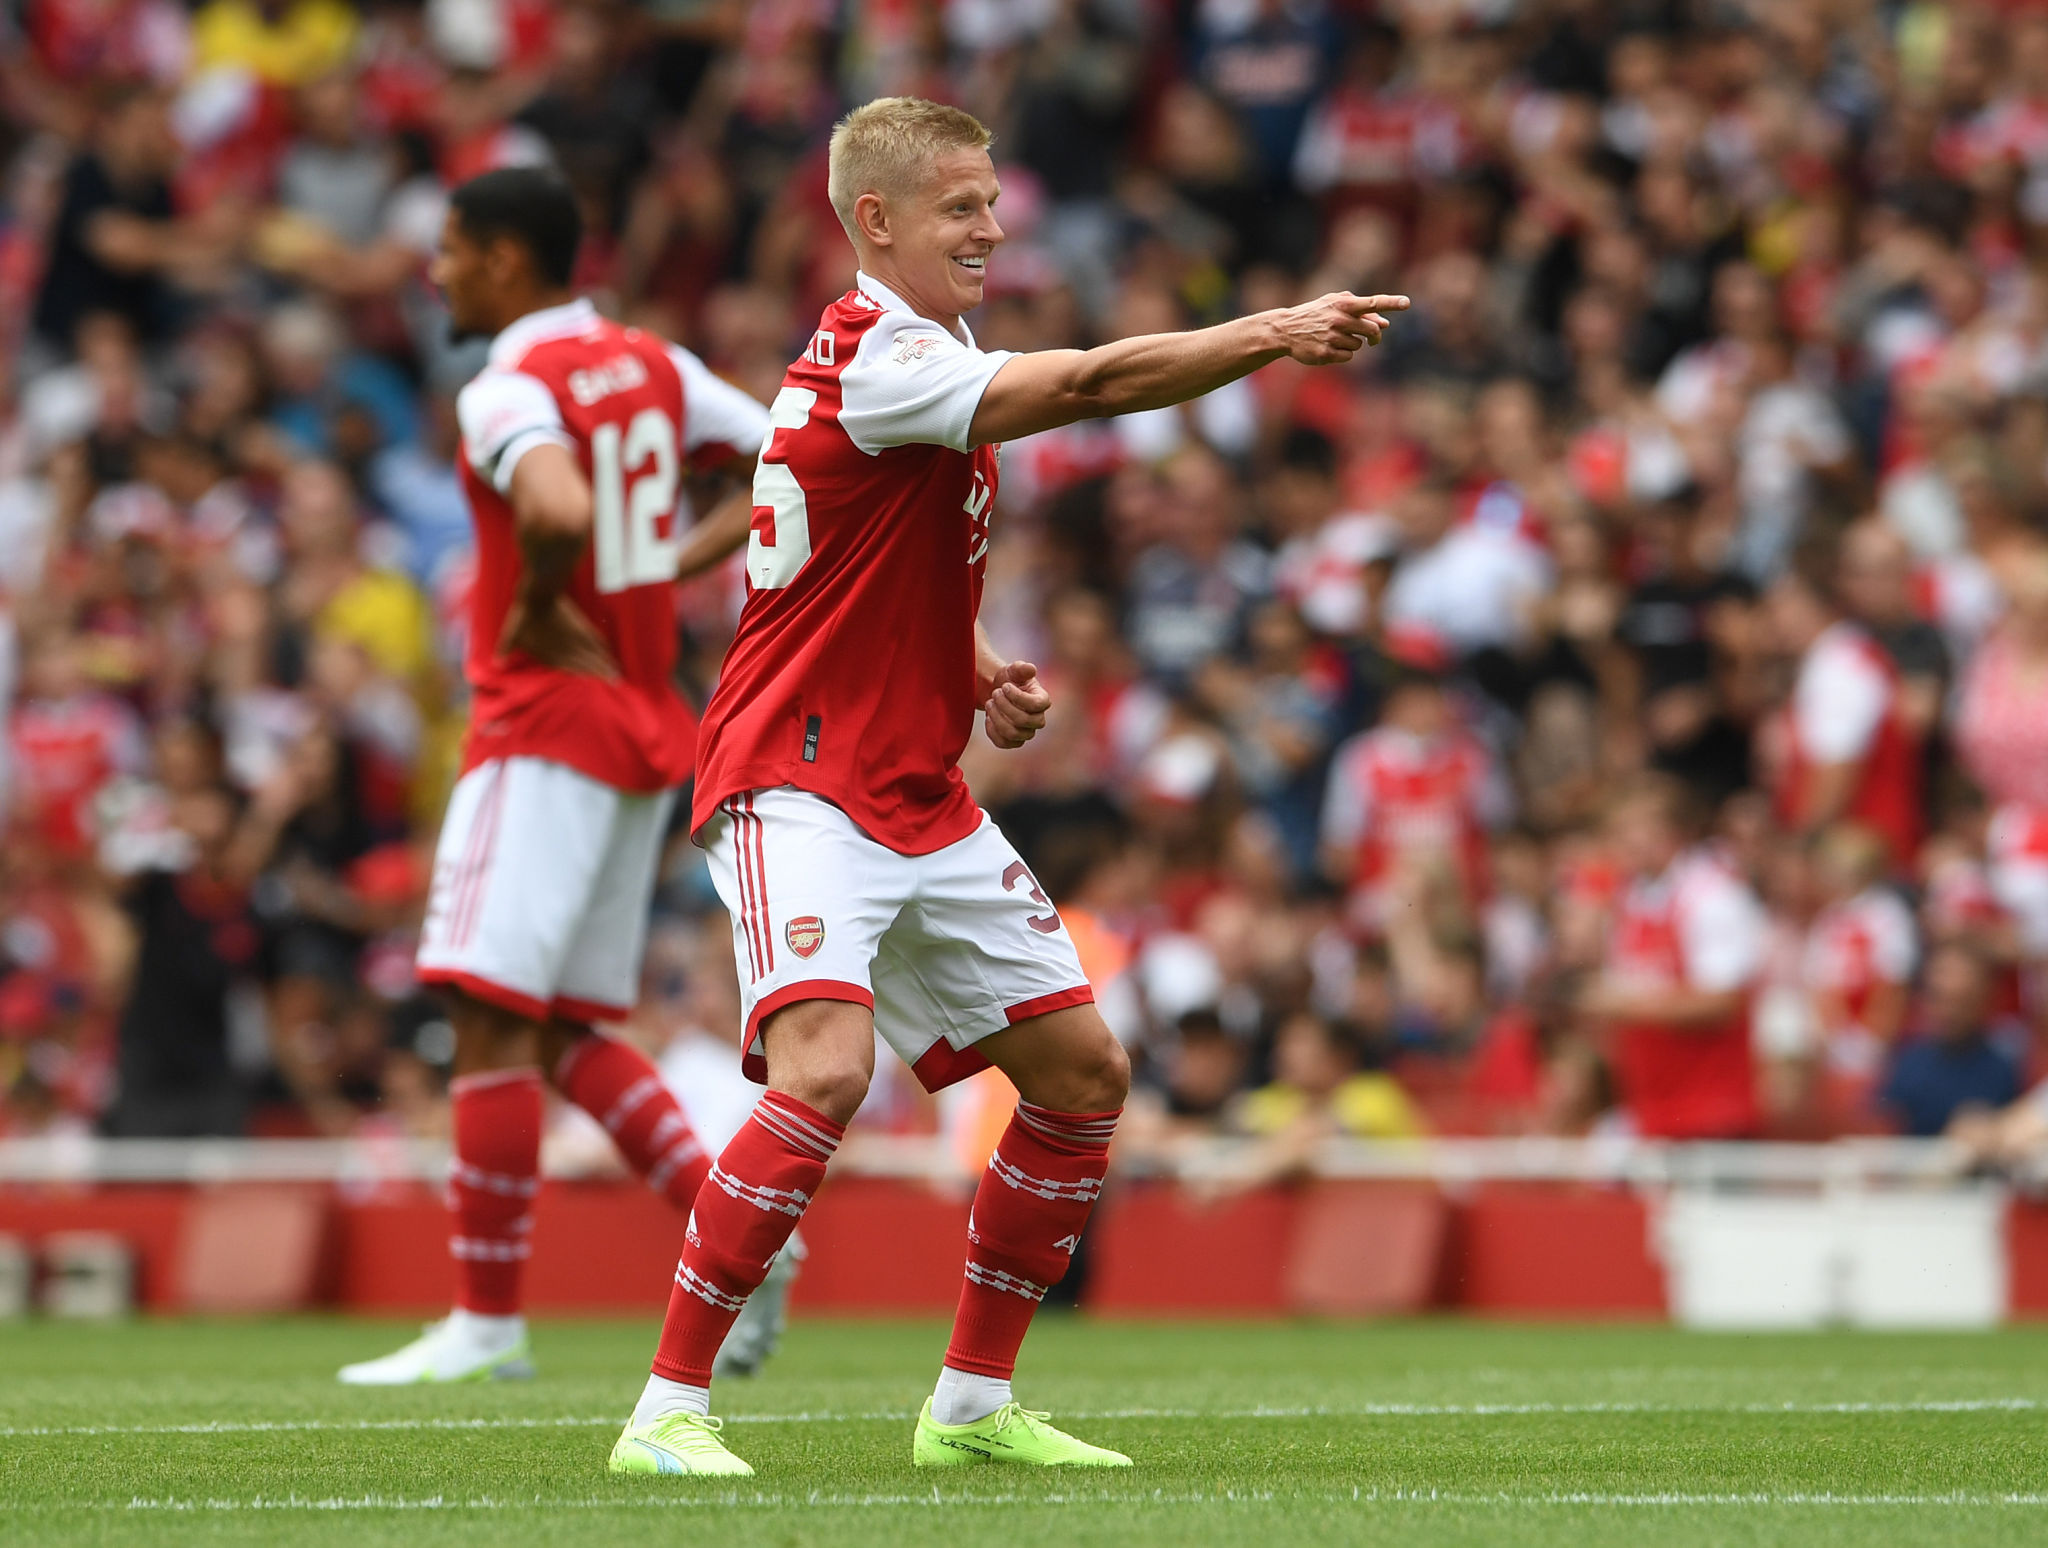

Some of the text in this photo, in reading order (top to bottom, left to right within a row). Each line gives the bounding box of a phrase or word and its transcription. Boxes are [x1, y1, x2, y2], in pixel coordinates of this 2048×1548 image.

[590, 408, 680, 594] 12
[1002, 860, 1061, 934] 3
[790, 922, 820, 931] Arsenal
[940, 1436, 992, 1458] ULTRA
